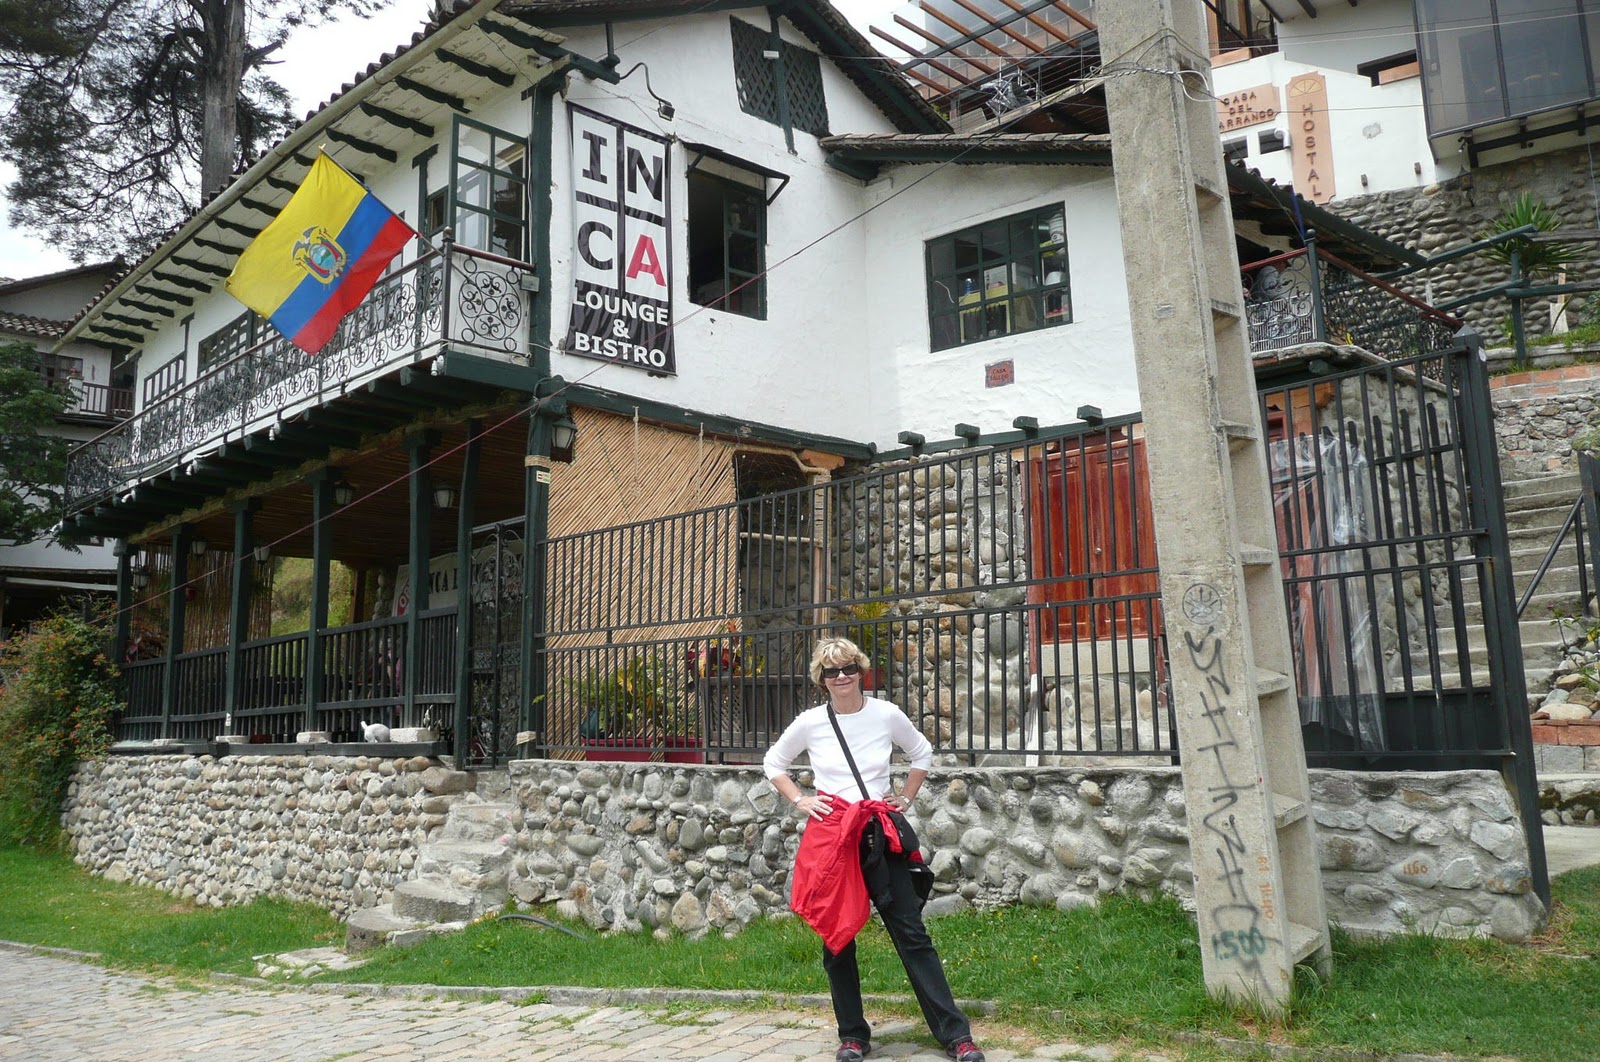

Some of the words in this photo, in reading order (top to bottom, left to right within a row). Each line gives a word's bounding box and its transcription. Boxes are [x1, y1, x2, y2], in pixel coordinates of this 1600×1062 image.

[1222, 92, 1256, 106] CASA
[1218, 109, 1273, 127] ARRANCO
[1229, 104, 1253, 116] DEL
[1302, 103, 1322, 198] HOSTAL
[573, 290, 668, 326] LOUNGE
[612, 318, 631, 339] &
[574, 332, 667, 367] BISTRO
